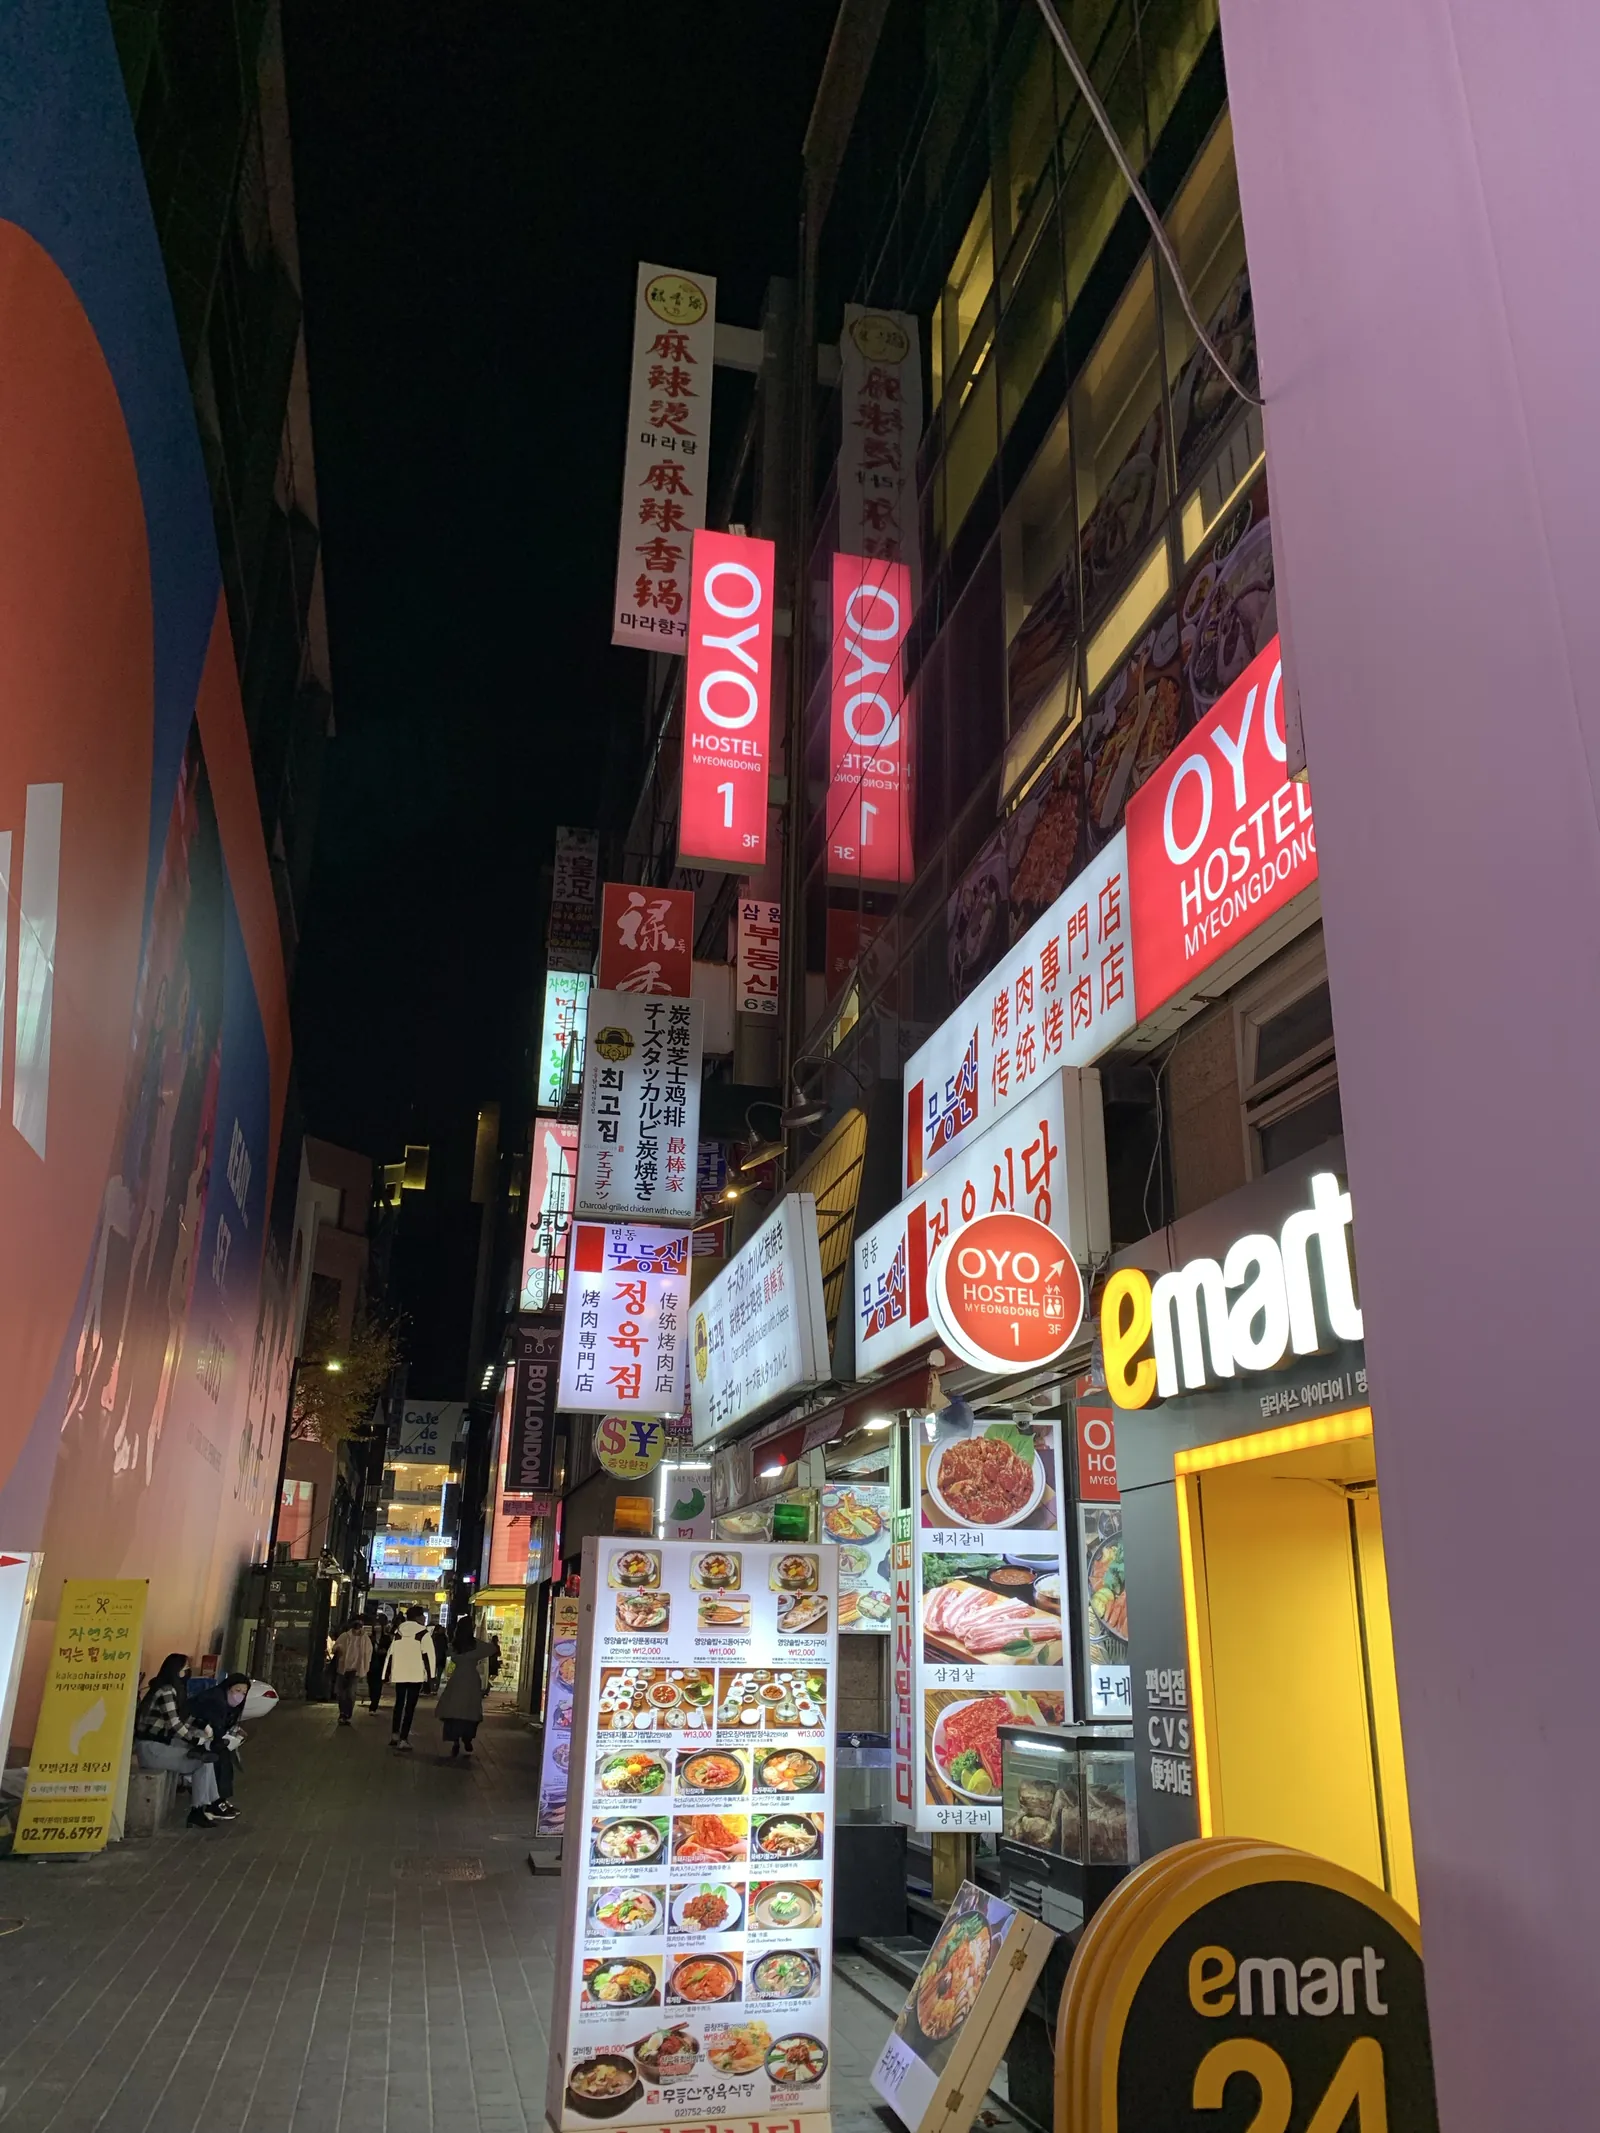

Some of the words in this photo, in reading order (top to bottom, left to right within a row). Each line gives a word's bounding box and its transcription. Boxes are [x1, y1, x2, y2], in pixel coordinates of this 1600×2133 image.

[646, 330, 699, 436] 麻辣烫
[640, 432, 698, 455] 마라탕
[633, 459, 694, 615] 麻辣香锅
[699, 562, 761, 729] OYO
[691, 733, 763, 757] HOSTEL
[692, 755, 761, 772] MYEONGDONG
[716, 782, 734, 828] 1
[742, 834, 760, 848] 3F
[1180, 781, 1313, 927] HOSTEL
[743, 924, 779, 996] 부동산
[744, 998, 777, 1013] 6층
[991, 941, 1126, 1108] 传统烤肉店
[925, 1037, 978, 1140] 무등산
[597, 1068, 624, 1143] 최고집
[634, 1002, 665, 1201] チーズタッカルビ炭焼き
[665, 1137, 686, 1193] 最棒家
[579, 1200, 629, 1213] Charcoal-grilled
[630, 1203, 654, 1214] chicken
[655, 1205, 668, 1215] with
[669, 1206, 691, 1217] cheese
[612, 1228, 637, 1241] 명동
[607, 1239, 687, 1272] 무등산
[862, 1236, 879, 1270] 명동
[957, 1247, 1040, 1283] OYO
[963, 1284, 1040, 1306] HOSTEL
[1100, 1172, 1365, 1410] emart
[964, 1303, 1040, 1317] MYEONGDONG
[606, 1280, 649, 1399] 정육점
[1010, 1322, 1020, 1346] 1
[1048, 1324, 1061, 1335] 3F
[524, 1344, 555, 1354] BOY
[655, 1292, 678, 1393] 传统烤肉店
[527, 1364, 548, 1406] BOY
[1301, 1377, 1344, 1407] 아이디어
[404, 1411, 439, 1426] Cafe
[419, 1427, 437, 1441] de
[520, 1407, 544, 1485] LONDON
[607, 1459, 649, 1471] 중앙환전
[932, 1532, 984, 1548] 돼지갈비
[387, 1581, 413, 1589] MOMENT
[632, 1647, 661, 1655] ₩12,000
[708, 1647, 736, 1656] ₩11,000
[55, 1671, 126, 1681] kakaohairshop
[934, 1667, 975, 1683] 삼겹살
[1145, 1668, 1186, 1706] 편의점
[798, 1730, 825, 1738] ₩13,000
[1148, 1715, 1190, 1750] CVS
[1150, 1756, 1192, 1796] 便利店
[937, 1809, 991, 1826] 양념갈비
[22, 1826, 103, 1841] 02.776.6797
[1188, 1945, 1388, 2017] emart
[662, 2083, 755, 2104] 무등산정육식당
[1192, 2035, 1389, 2133] 24
[674, 2106, 727, 2118] 02)752-9292
